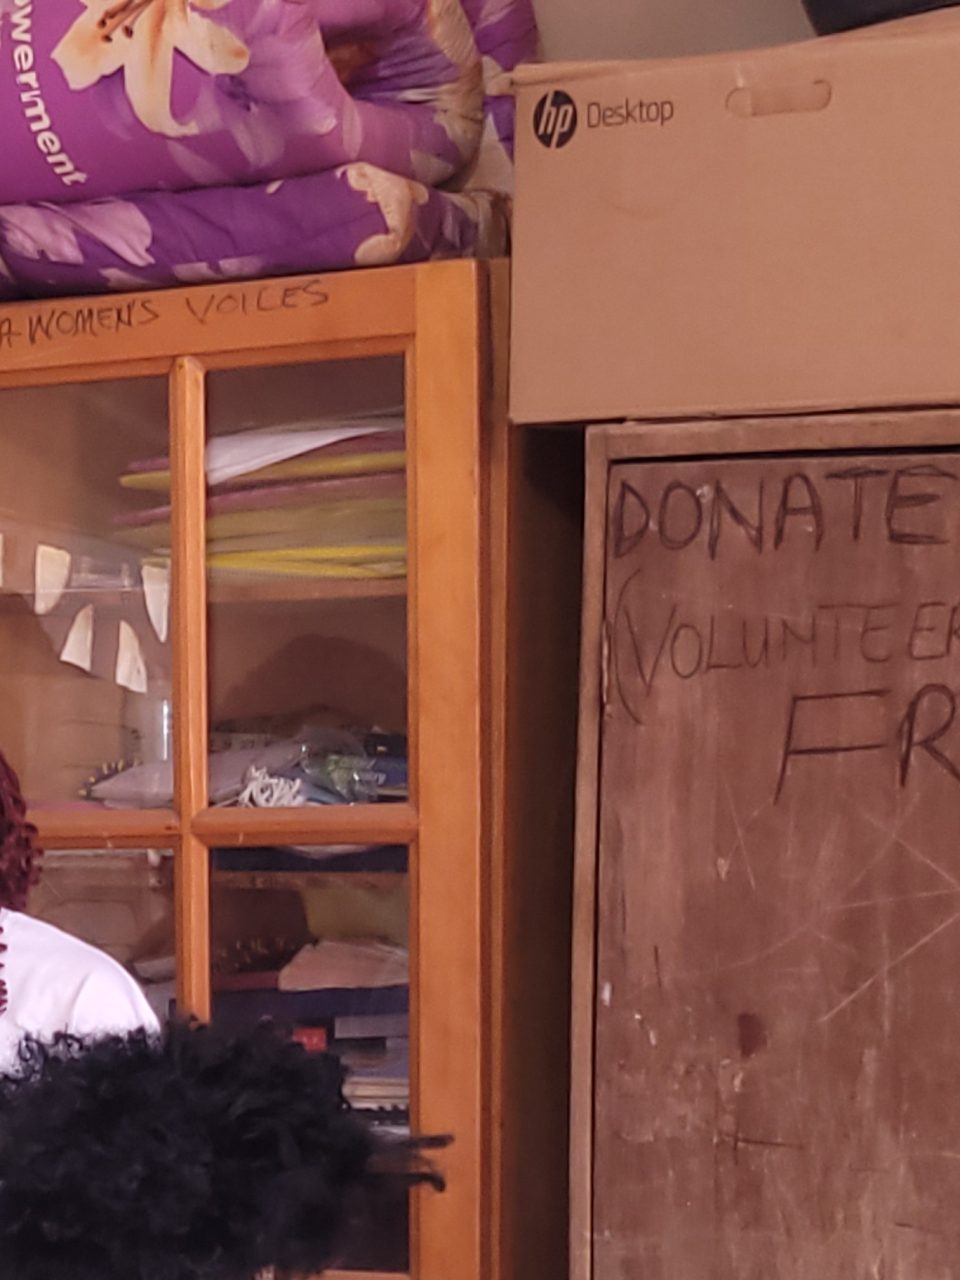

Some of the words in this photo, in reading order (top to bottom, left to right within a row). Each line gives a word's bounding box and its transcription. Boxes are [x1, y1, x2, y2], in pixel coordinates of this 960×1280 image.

[534, 89, 577, 149] hp
[586, 97, 674, 128] Desktop
[26, 299, 160, 343] WOMEN'S
[184, 279, 330, 325] VOICES
[613, 465, 959, 560] DONATE
